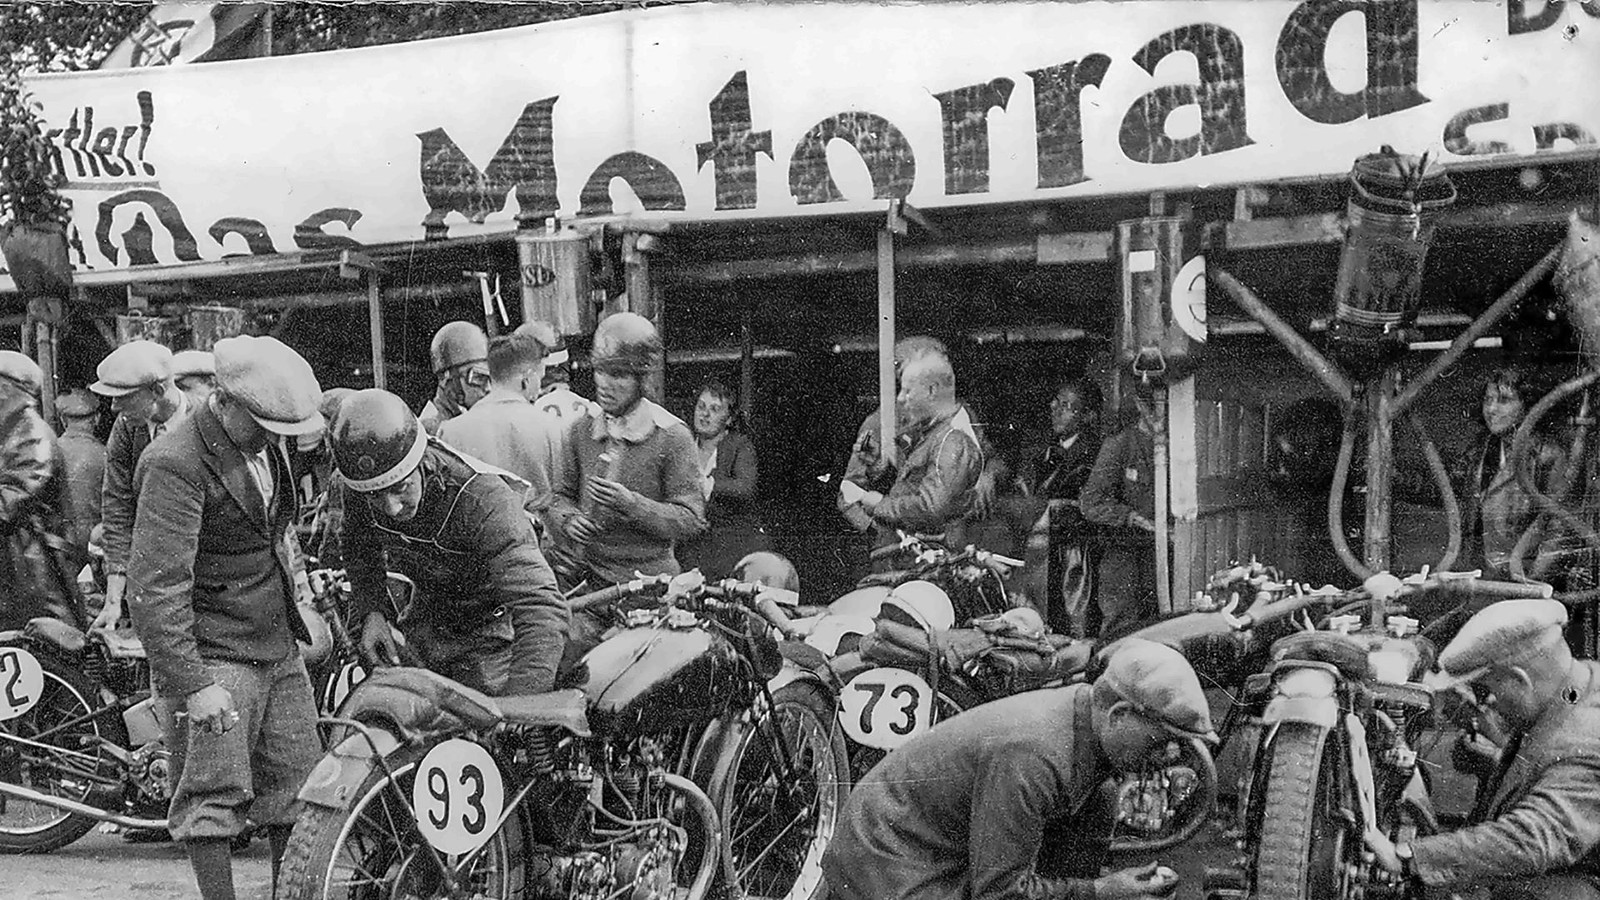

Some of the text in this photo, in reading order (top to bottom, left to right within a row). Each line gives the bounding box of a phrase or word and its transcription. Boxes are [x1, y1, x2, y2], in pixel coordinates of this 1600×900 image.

[412, 0, 1431, 242] Motorrad
[854, 683, 919, 735] 73
[427, 764, 486, 834] 93
